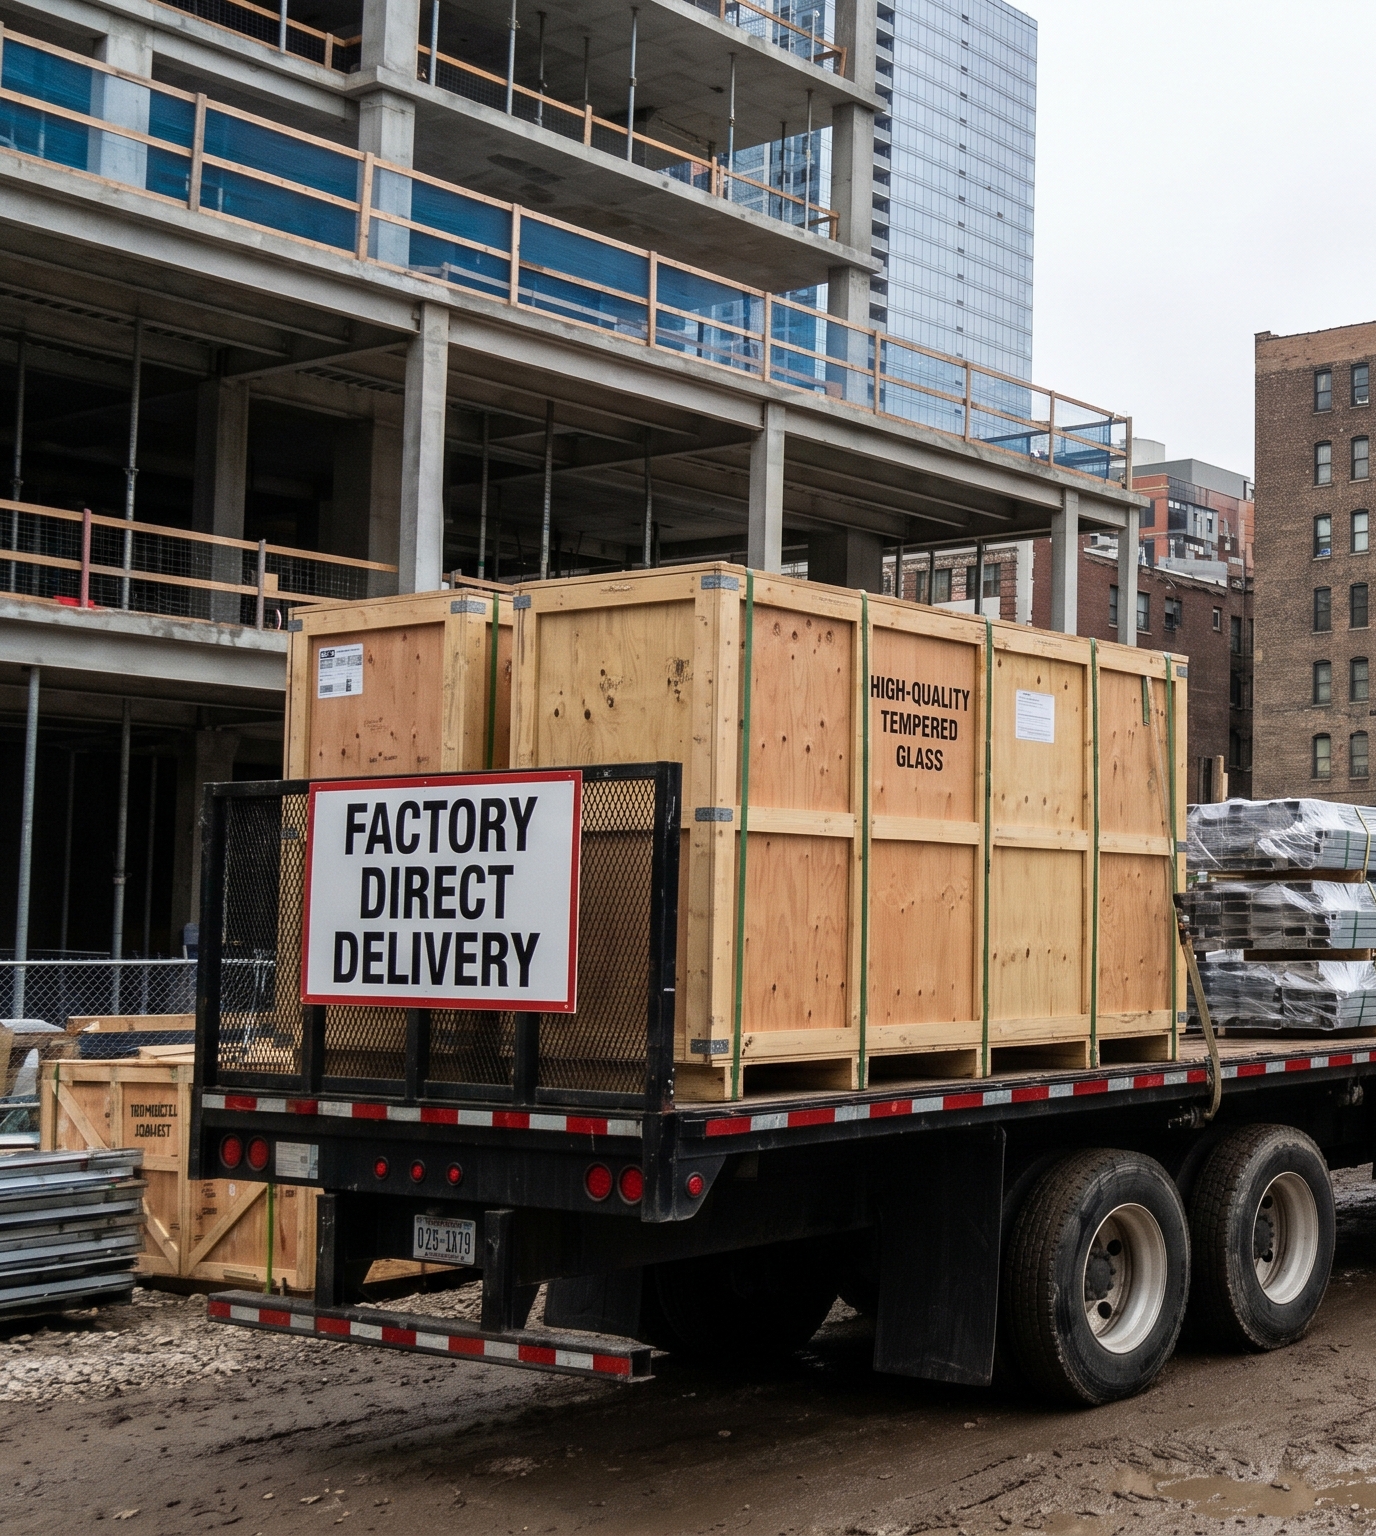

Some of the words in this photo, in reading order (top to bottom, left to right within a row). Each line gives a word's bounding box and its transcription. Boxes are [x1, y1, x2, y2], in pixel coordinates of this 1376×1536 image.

[871, 674, 970, 711] HIGH-QUALITY
[881, 710, 957, 741] TEMPERED
[896, 745, 943, 771] GLASS
[345, 796, 538, 855] FACTORY
[360, 865, 514, 920] DIRECT
[333, 931, 540, 987] DELIVERY
